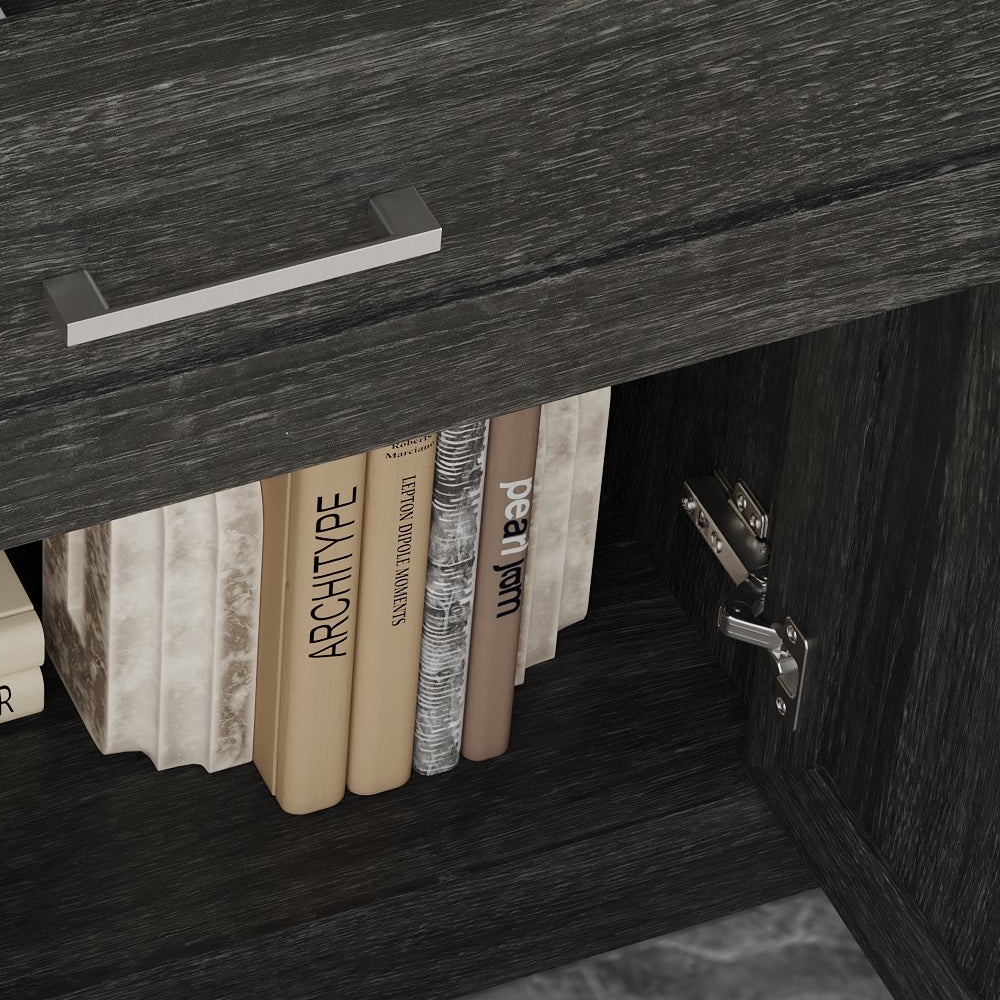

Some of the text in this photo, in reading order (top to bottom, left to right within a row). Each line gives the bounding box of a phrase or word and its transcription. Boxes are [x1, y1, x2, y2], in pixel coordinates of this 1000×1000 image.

[308, 486, 359, 660] ARCHITYPE
[391, 474, 417, 628] LEPTON DIPOLE MOMENTS
[493, 477, 535, 619] pearl jam
